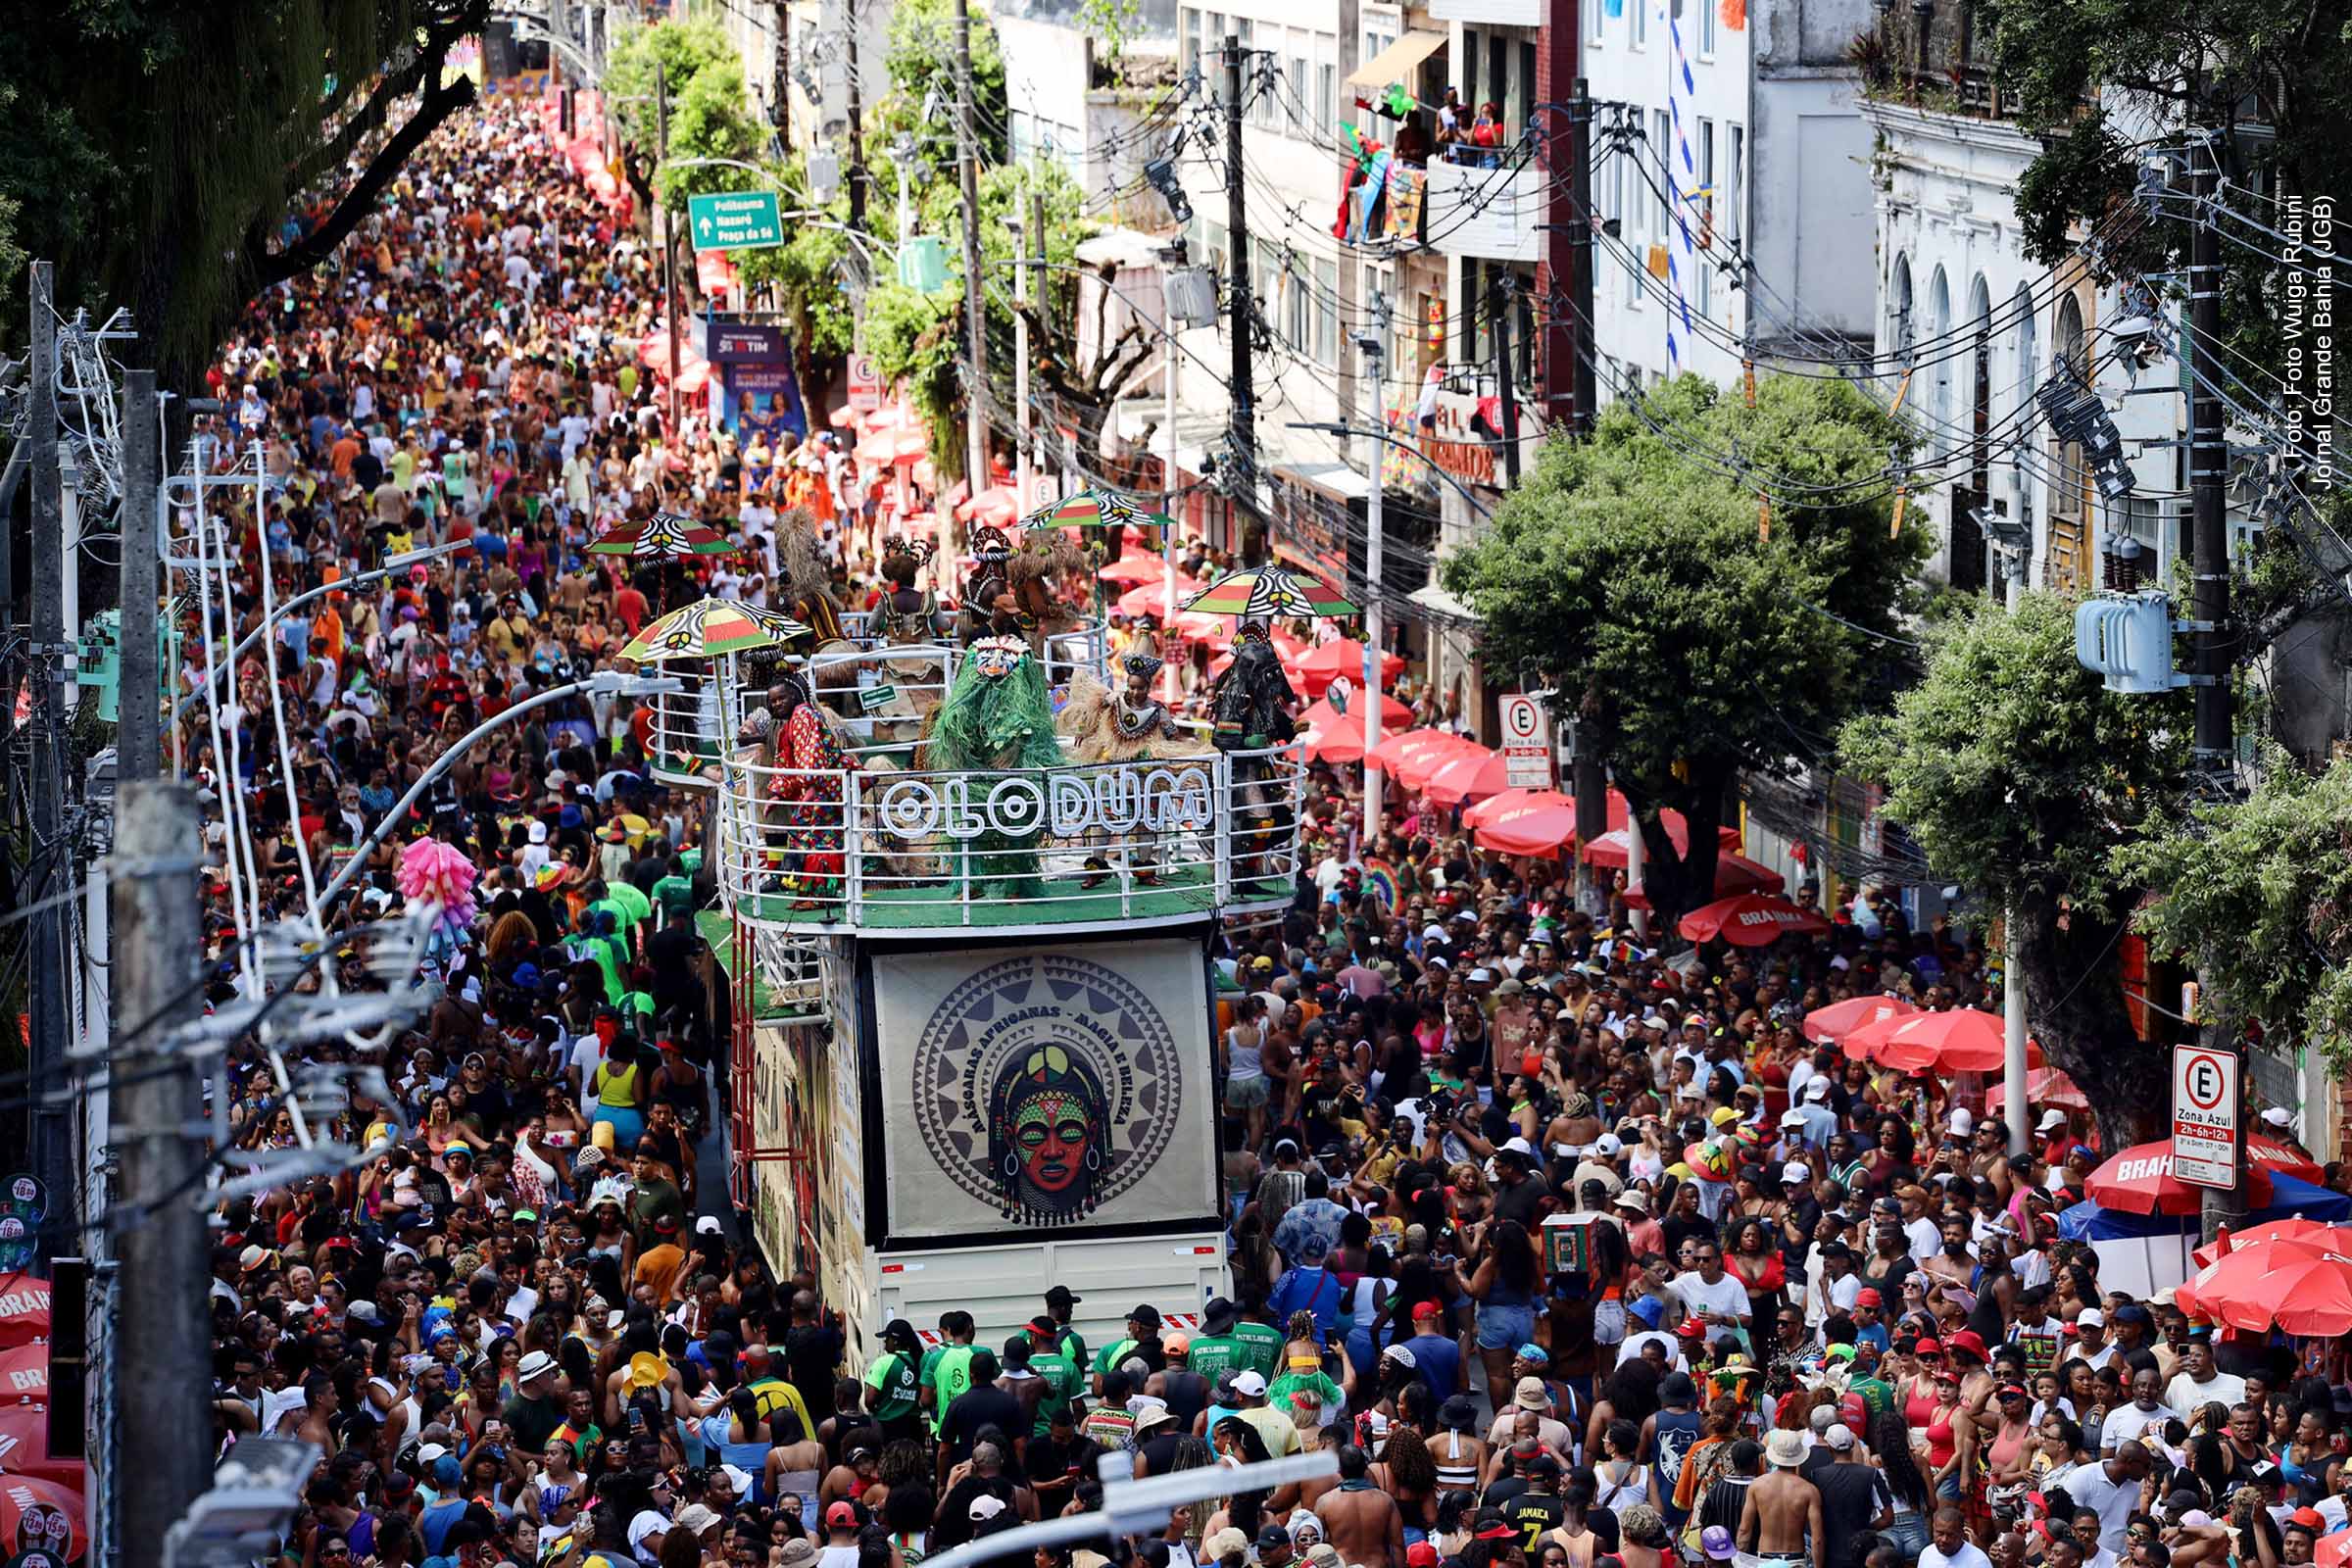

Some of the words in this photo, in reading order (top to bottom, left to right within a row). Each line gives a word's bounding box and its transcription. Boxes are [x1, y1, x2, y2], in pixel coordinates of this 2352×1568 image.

[716, 212, 752, 226] Nazaré
[717, 229, 745, 243] Praça
[746, 227, 760, 240] da
[760, 224, 773, 238] Sé
[748, 341, 768, 353] TIM
[1518, 709, 1528, 728] E
[881, 767, 1213, 839] OLODUM
[961, 1047, 987, 1134] MÁSCARAS
[978, 1005, 1061, 1049] AFRICANAS
[1112, 1064, 1133, 1125] BELEZA
[2197, 1066, 2212, 1099] E
[2178, 1108, 2203, 1122] Zona
[2207, 1114, 2230, 1127] Azul
[2180, 1123, 2229, 1141] 2h-6h-12h
[9, 1366, 48, 1391] BR
[1517, 1507, 1548, 1521] JAMAICA
[1524, 1523, 1542, 1552] 7
